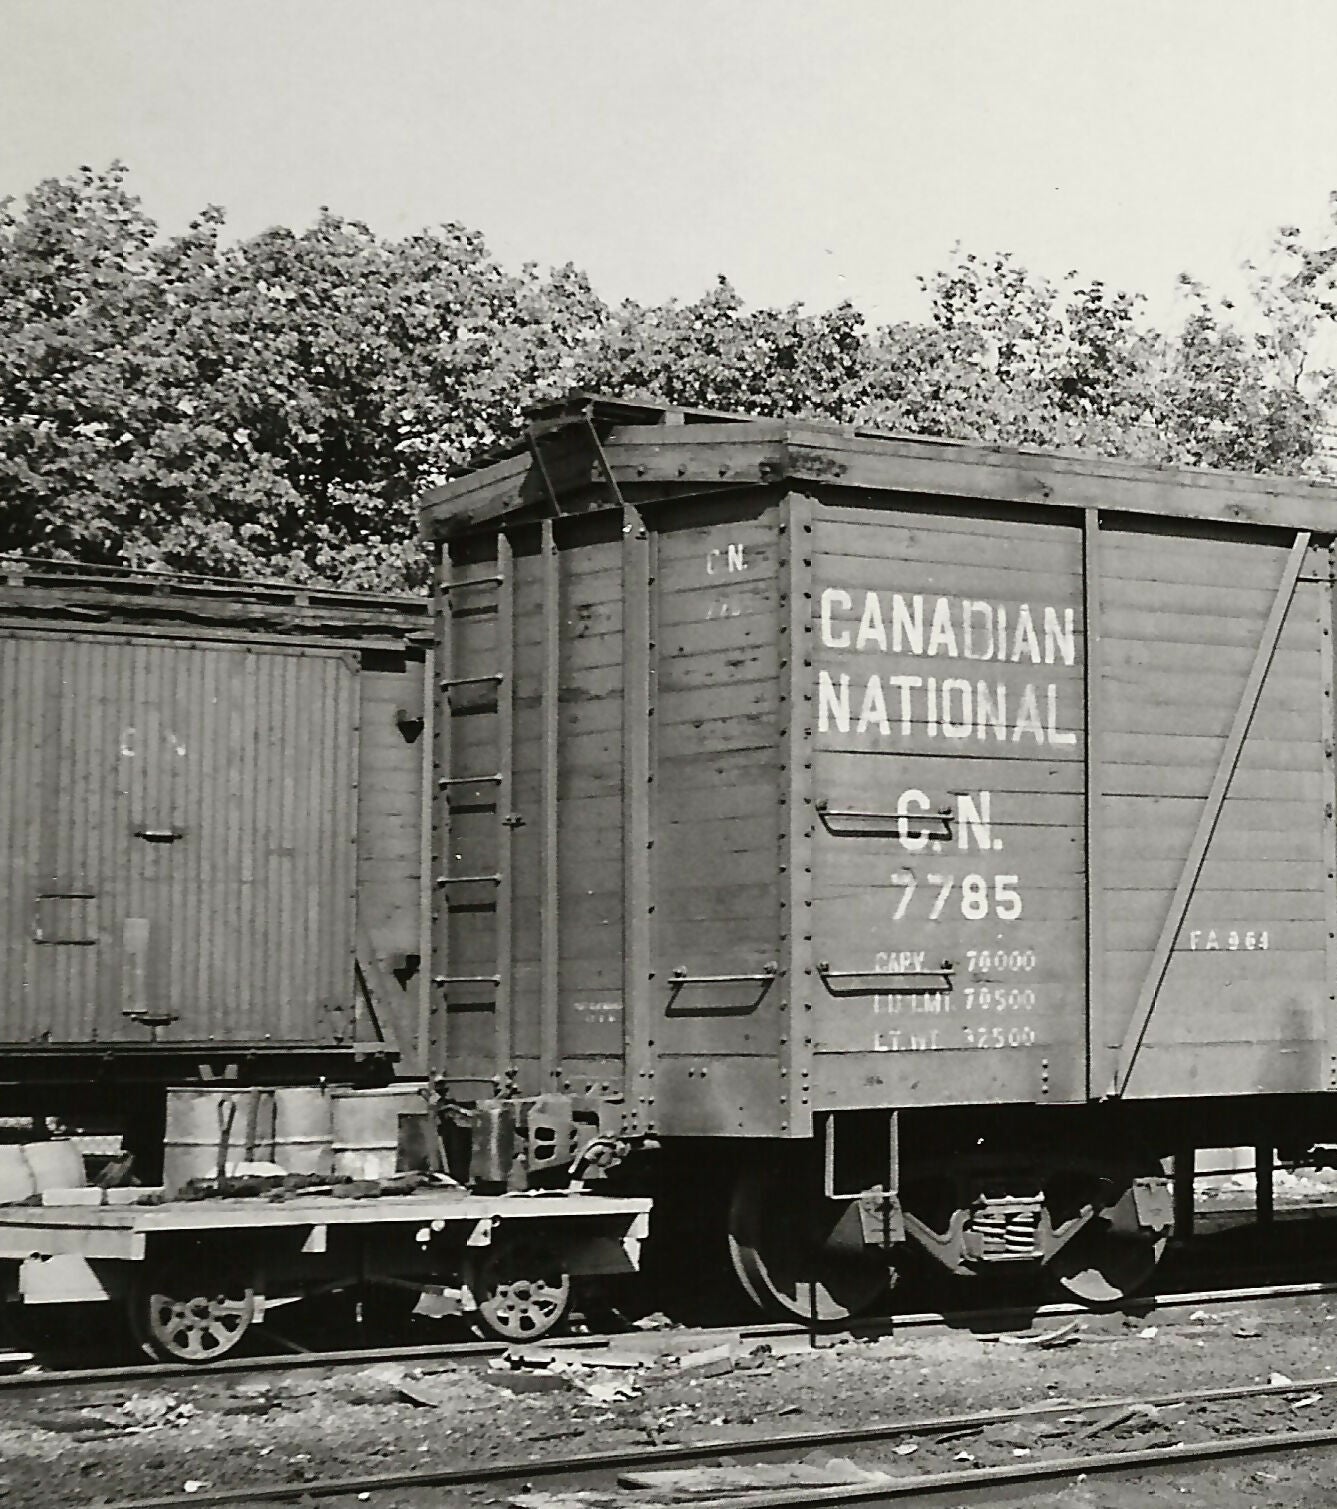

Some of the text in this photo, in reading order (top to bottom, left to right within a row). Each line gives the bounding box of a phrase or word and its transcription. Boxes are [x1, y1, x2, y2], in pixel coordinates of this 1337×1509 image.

[820, 587, 1074, 666] CANADIAN
[818, 669, 1078, 745] NATIONAL
[896, 788, 1003, 852] C.N.
[890, 873, 1023, 921] 7785
